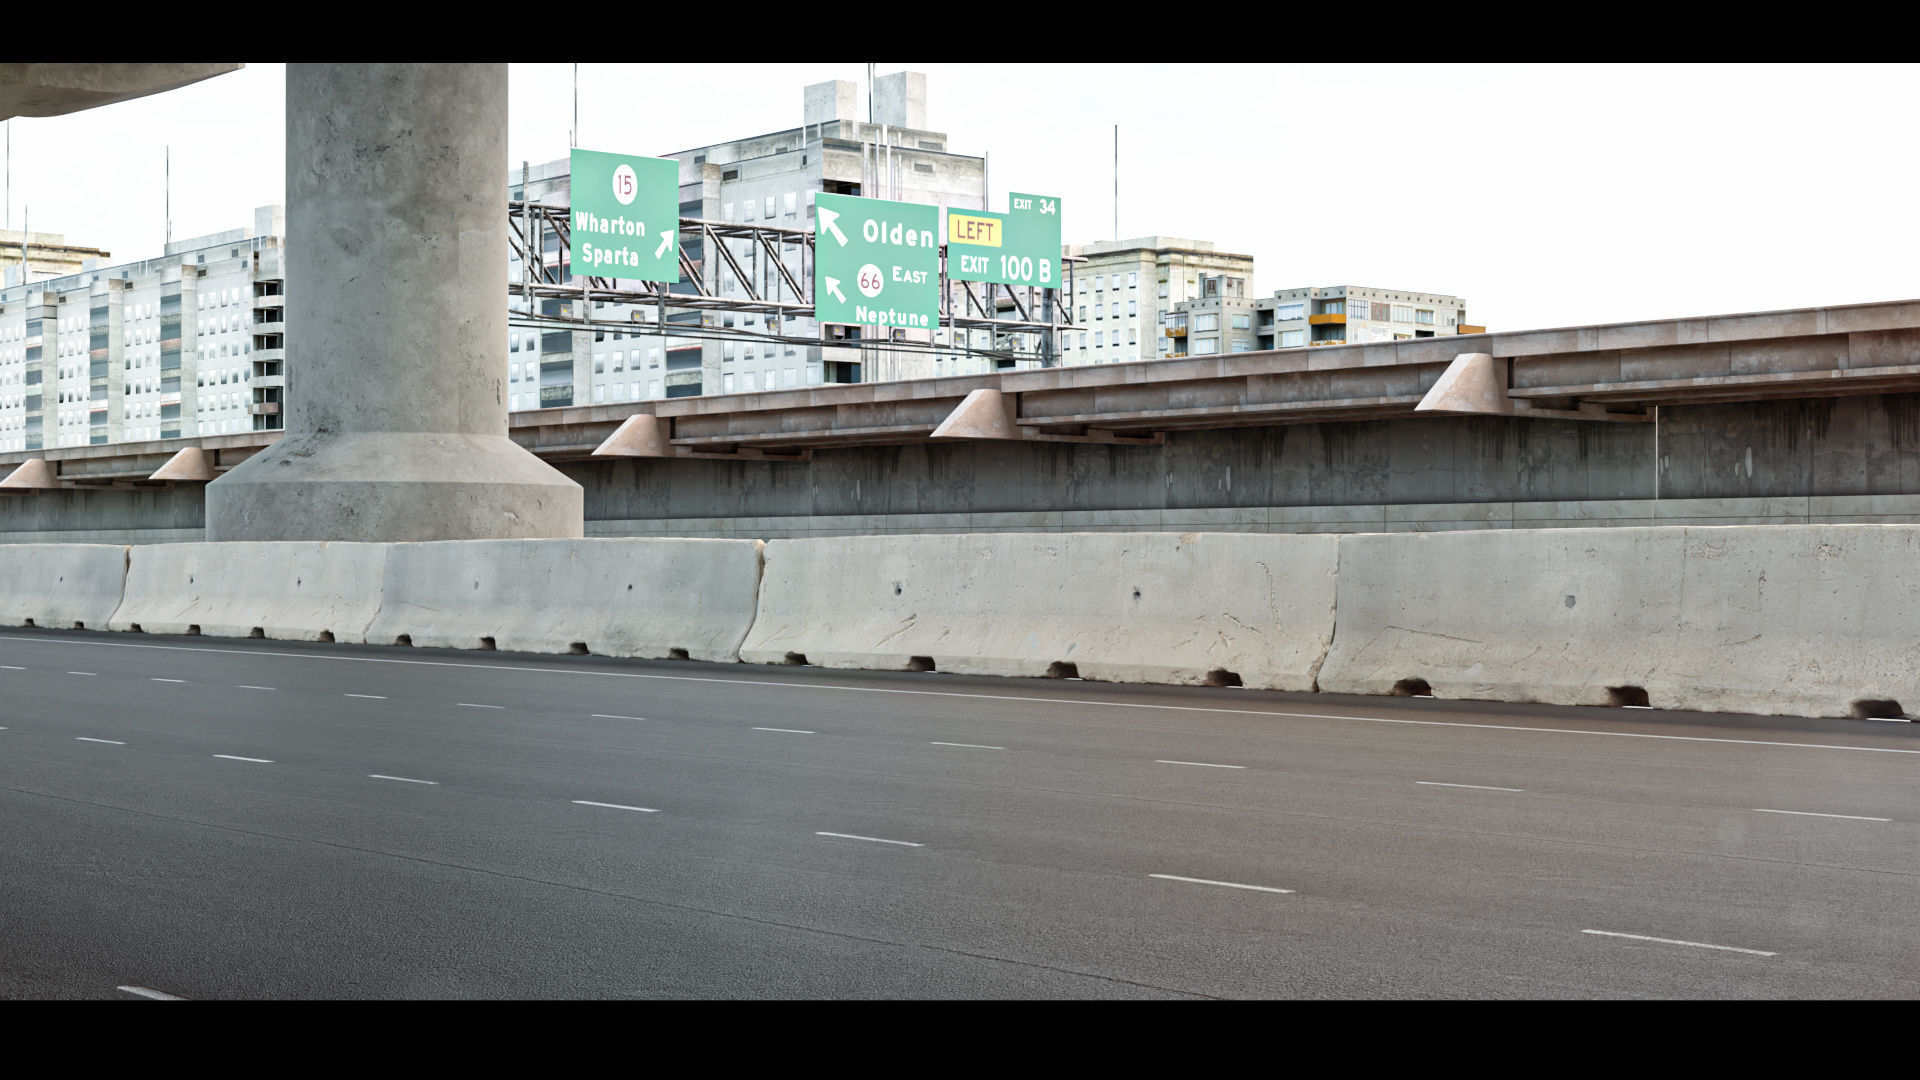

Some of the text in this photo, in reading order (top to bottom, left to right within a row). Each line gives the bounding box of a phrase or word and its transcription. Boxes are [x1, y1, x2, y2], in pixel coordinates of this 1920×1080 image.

[618, 174, 632, 195] 15
[1013, 198, 1056, 215] EXIT 34
[575, 211, 645, 237] Wharton
[863, 219, 933, 248] Olden
[957, 219, 994, 242] LEFT
[582, 242, 639, 268] Sparta
[860, 265, 928, 290] 66 EAST
[960, 254, 1051, 283] EXIT 100 B
[855, 305, 929, 327] Neptune
